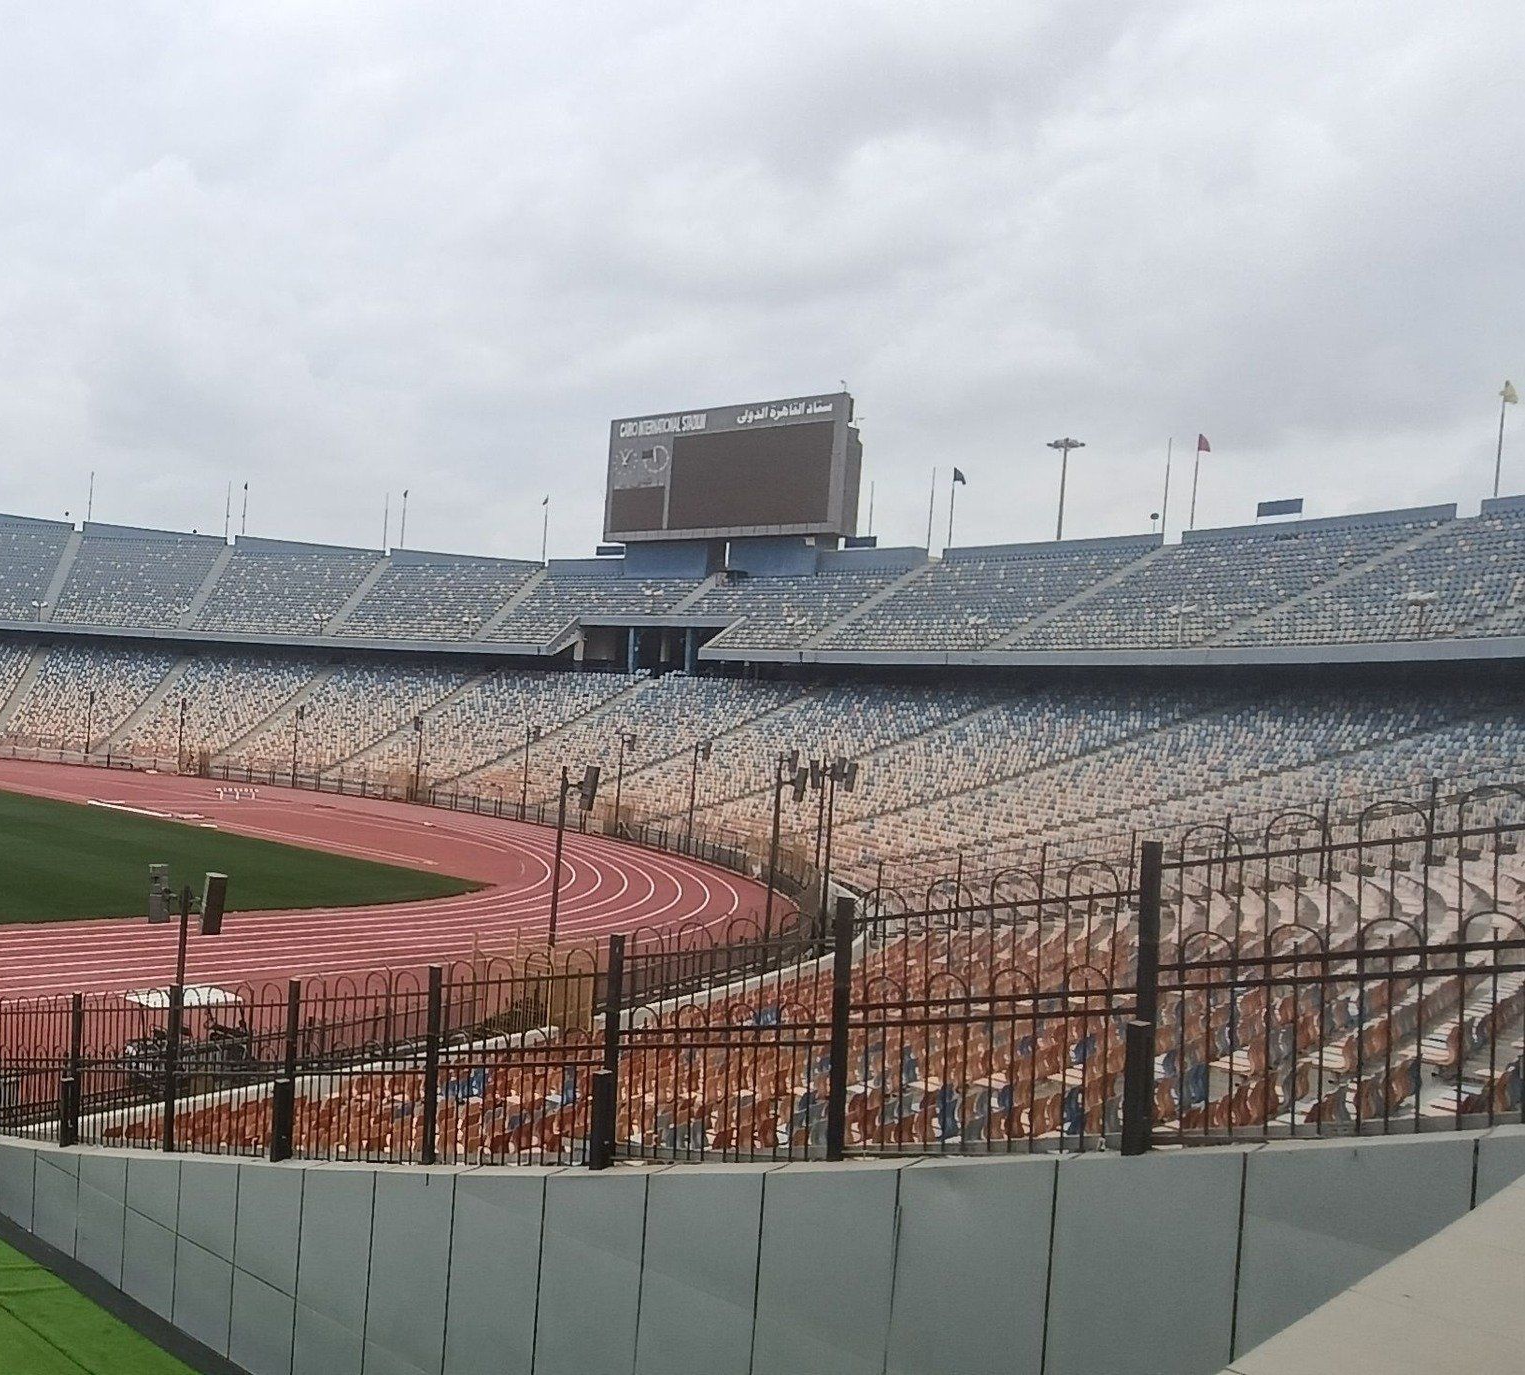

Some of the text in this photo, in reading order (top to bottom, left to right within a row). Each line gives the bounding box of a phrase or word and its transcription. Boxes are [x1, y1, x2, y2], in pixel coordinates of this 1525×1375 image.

[770, 402, 806, 420] القاهرة
[806, 400, 833, 414] ستاد
[620, 413, 706, 438] CAIRO INTERNATIONAL STADIUM
